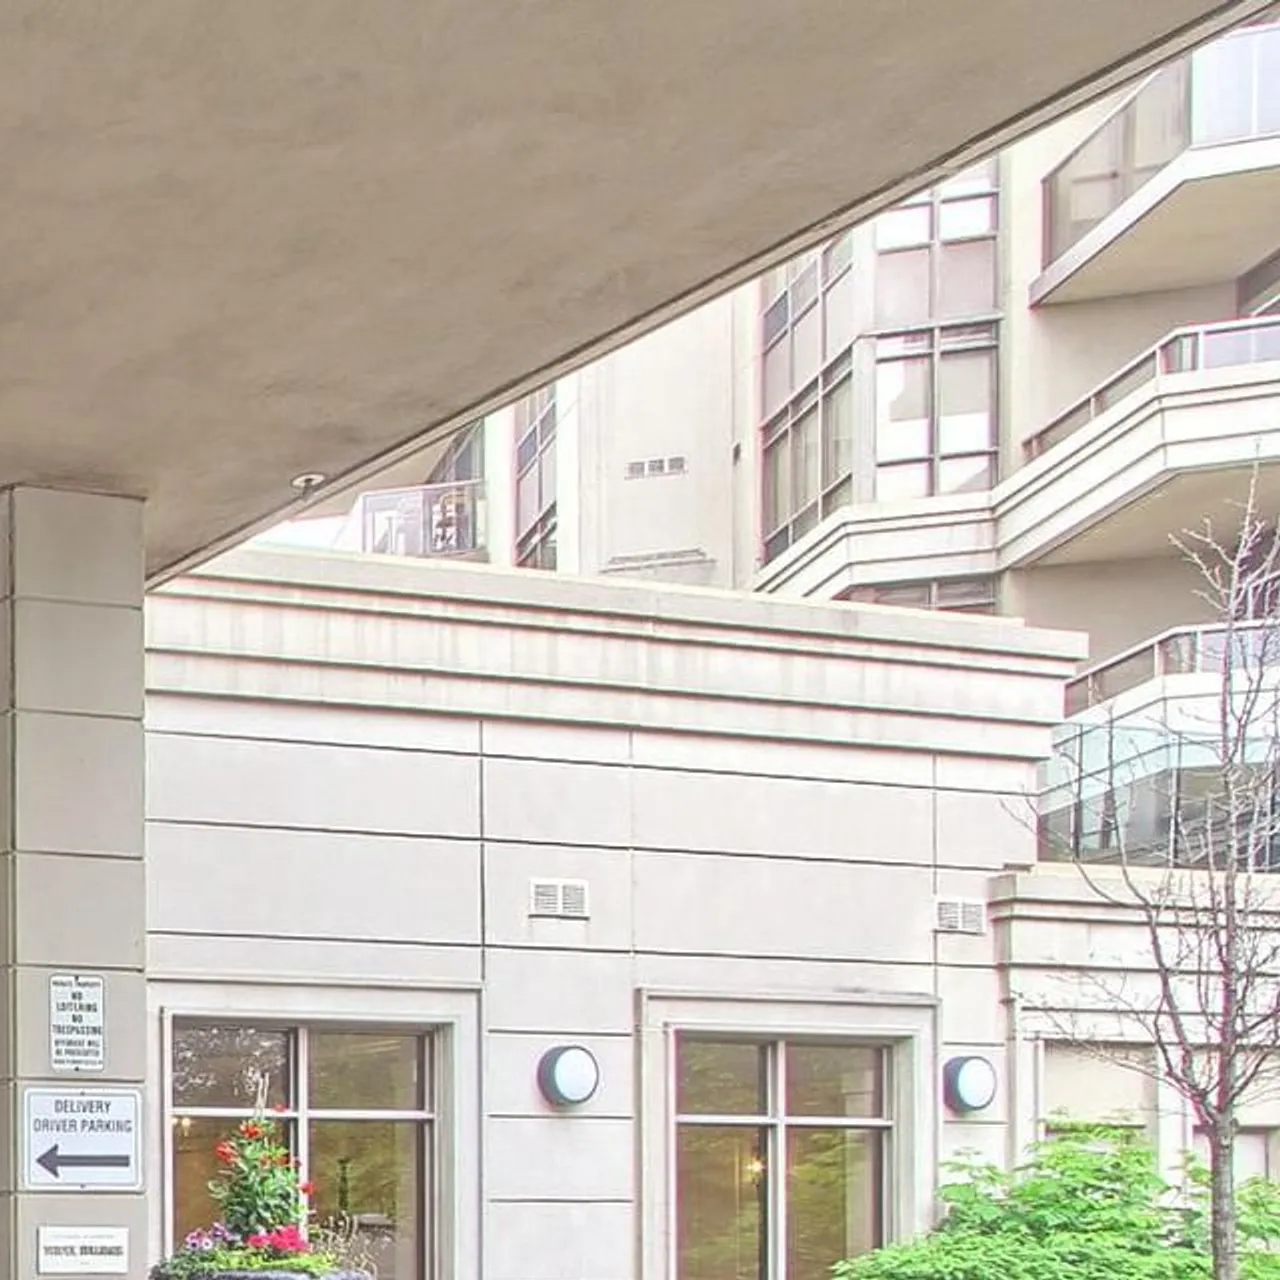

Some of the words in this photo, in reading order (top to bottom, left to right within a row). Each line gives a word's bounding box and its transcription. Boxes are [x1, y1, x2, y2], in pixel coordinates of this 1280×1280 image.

[54, 1100, 111, 1113] DELIVERY
[34, 1119, 77, 1132] DRIVER
[81, 1120, 132, 1132] PARKING
